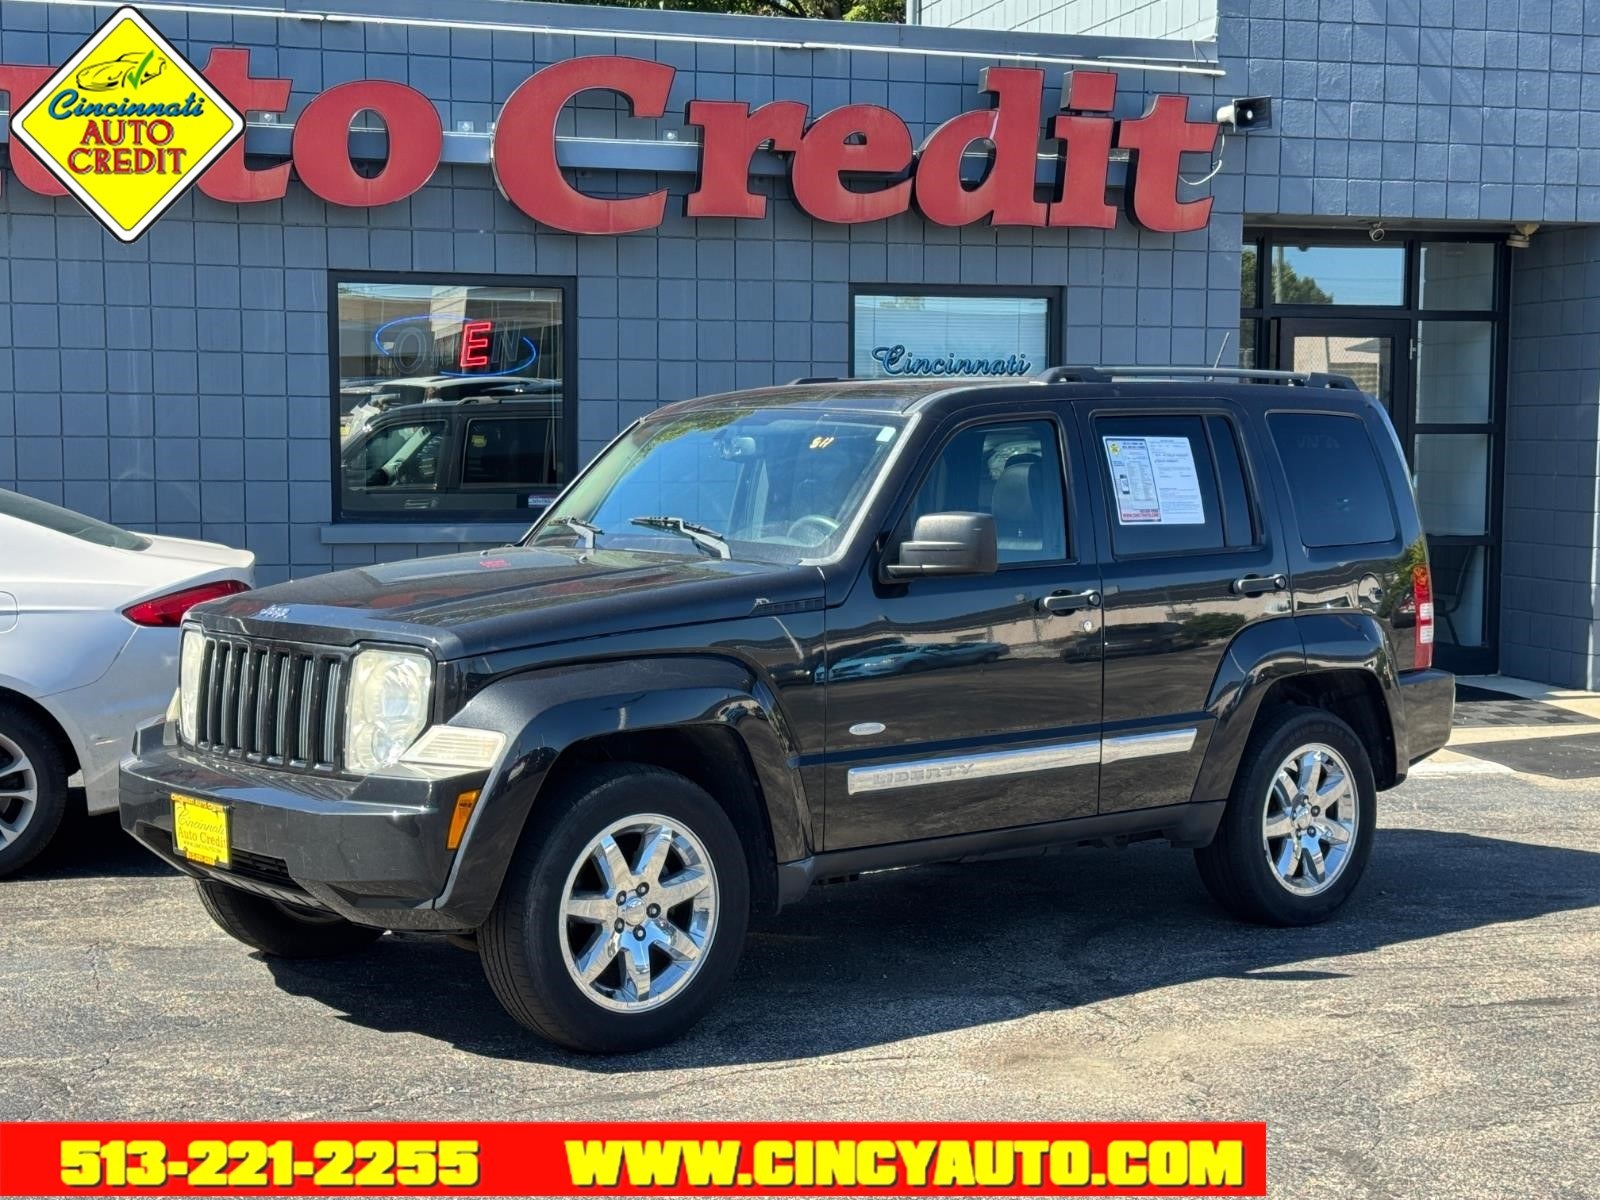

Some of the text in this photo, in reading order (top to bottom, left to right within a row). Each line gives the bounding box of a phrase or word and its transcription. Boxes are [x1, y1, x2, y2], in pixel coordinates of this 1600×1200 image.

[492, 55, 1219, 236] Credit
[871, 344, 1033, 377] Cincinnati
[178, 826, 198, 842] Auto
